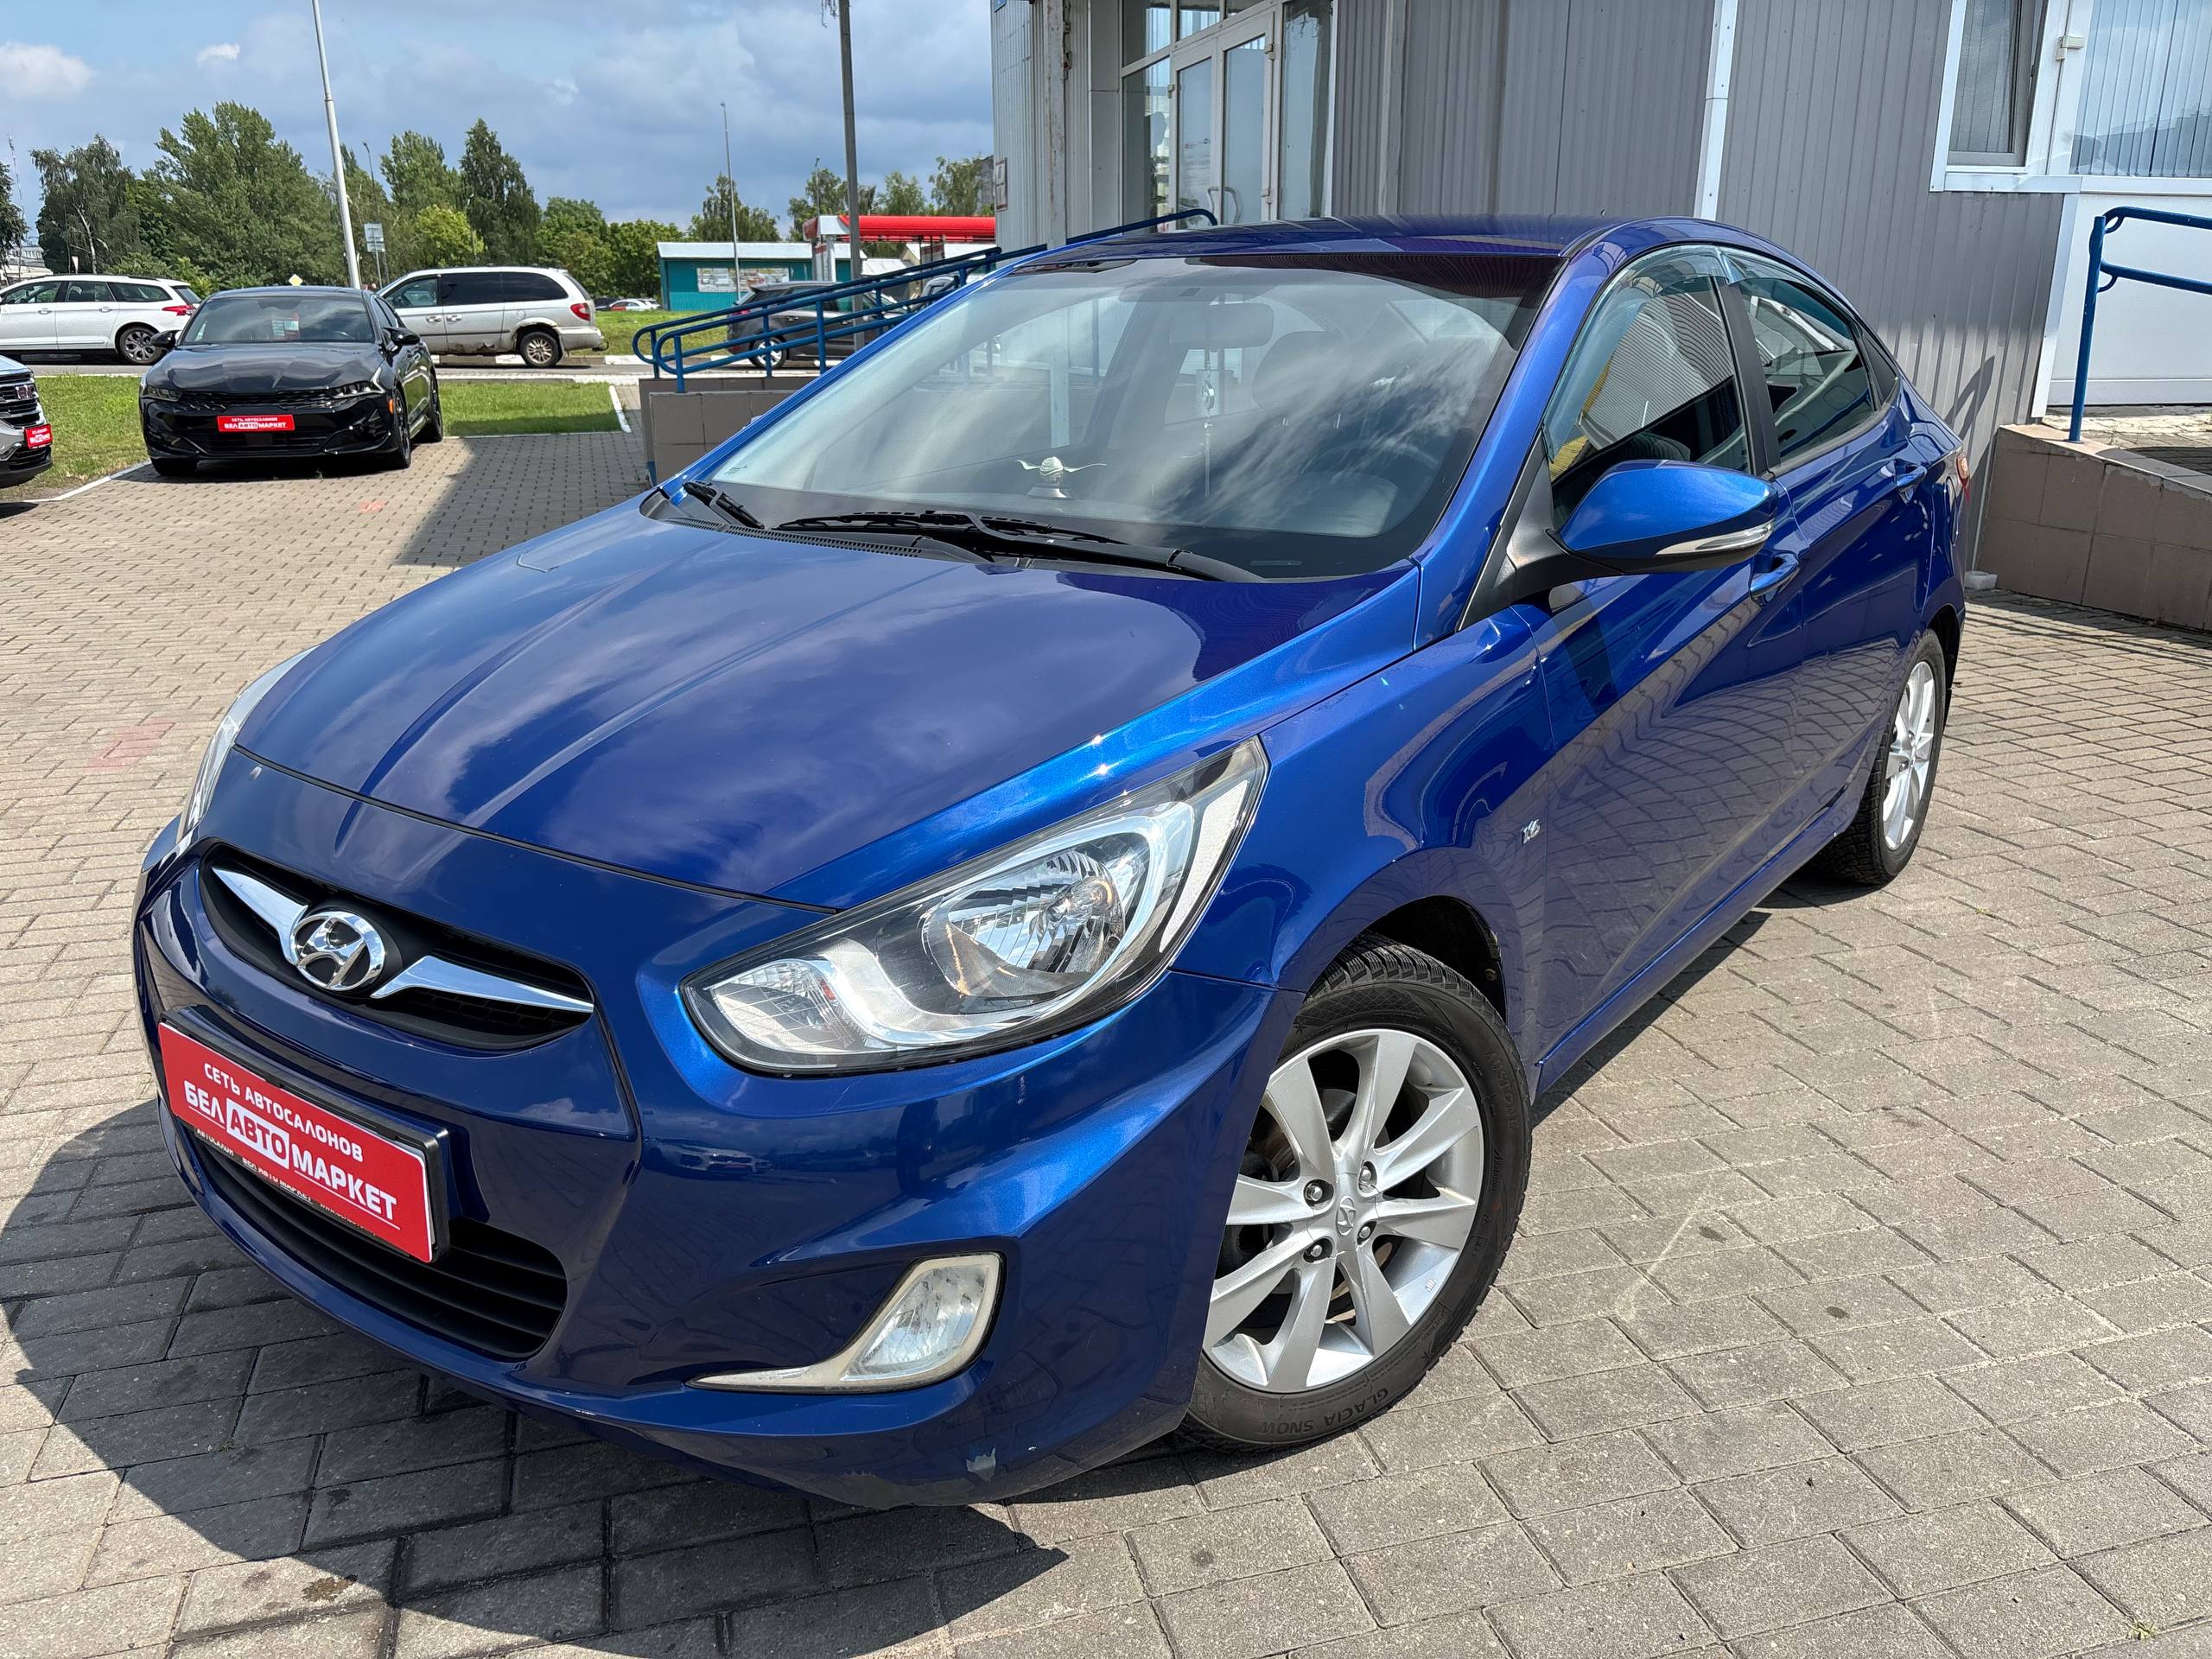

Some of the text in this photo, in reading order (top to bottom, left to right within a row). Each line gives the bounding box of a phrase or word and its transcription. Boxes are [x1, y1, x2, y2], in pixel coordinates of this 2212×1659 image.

[204, 1062, 364, 1163] СЕТЬ АВТОСАЛОНОВ
[1258, 1419, 1314, 1435] SNOW
[1323, 1388, 1389, 1427] GLACIA
